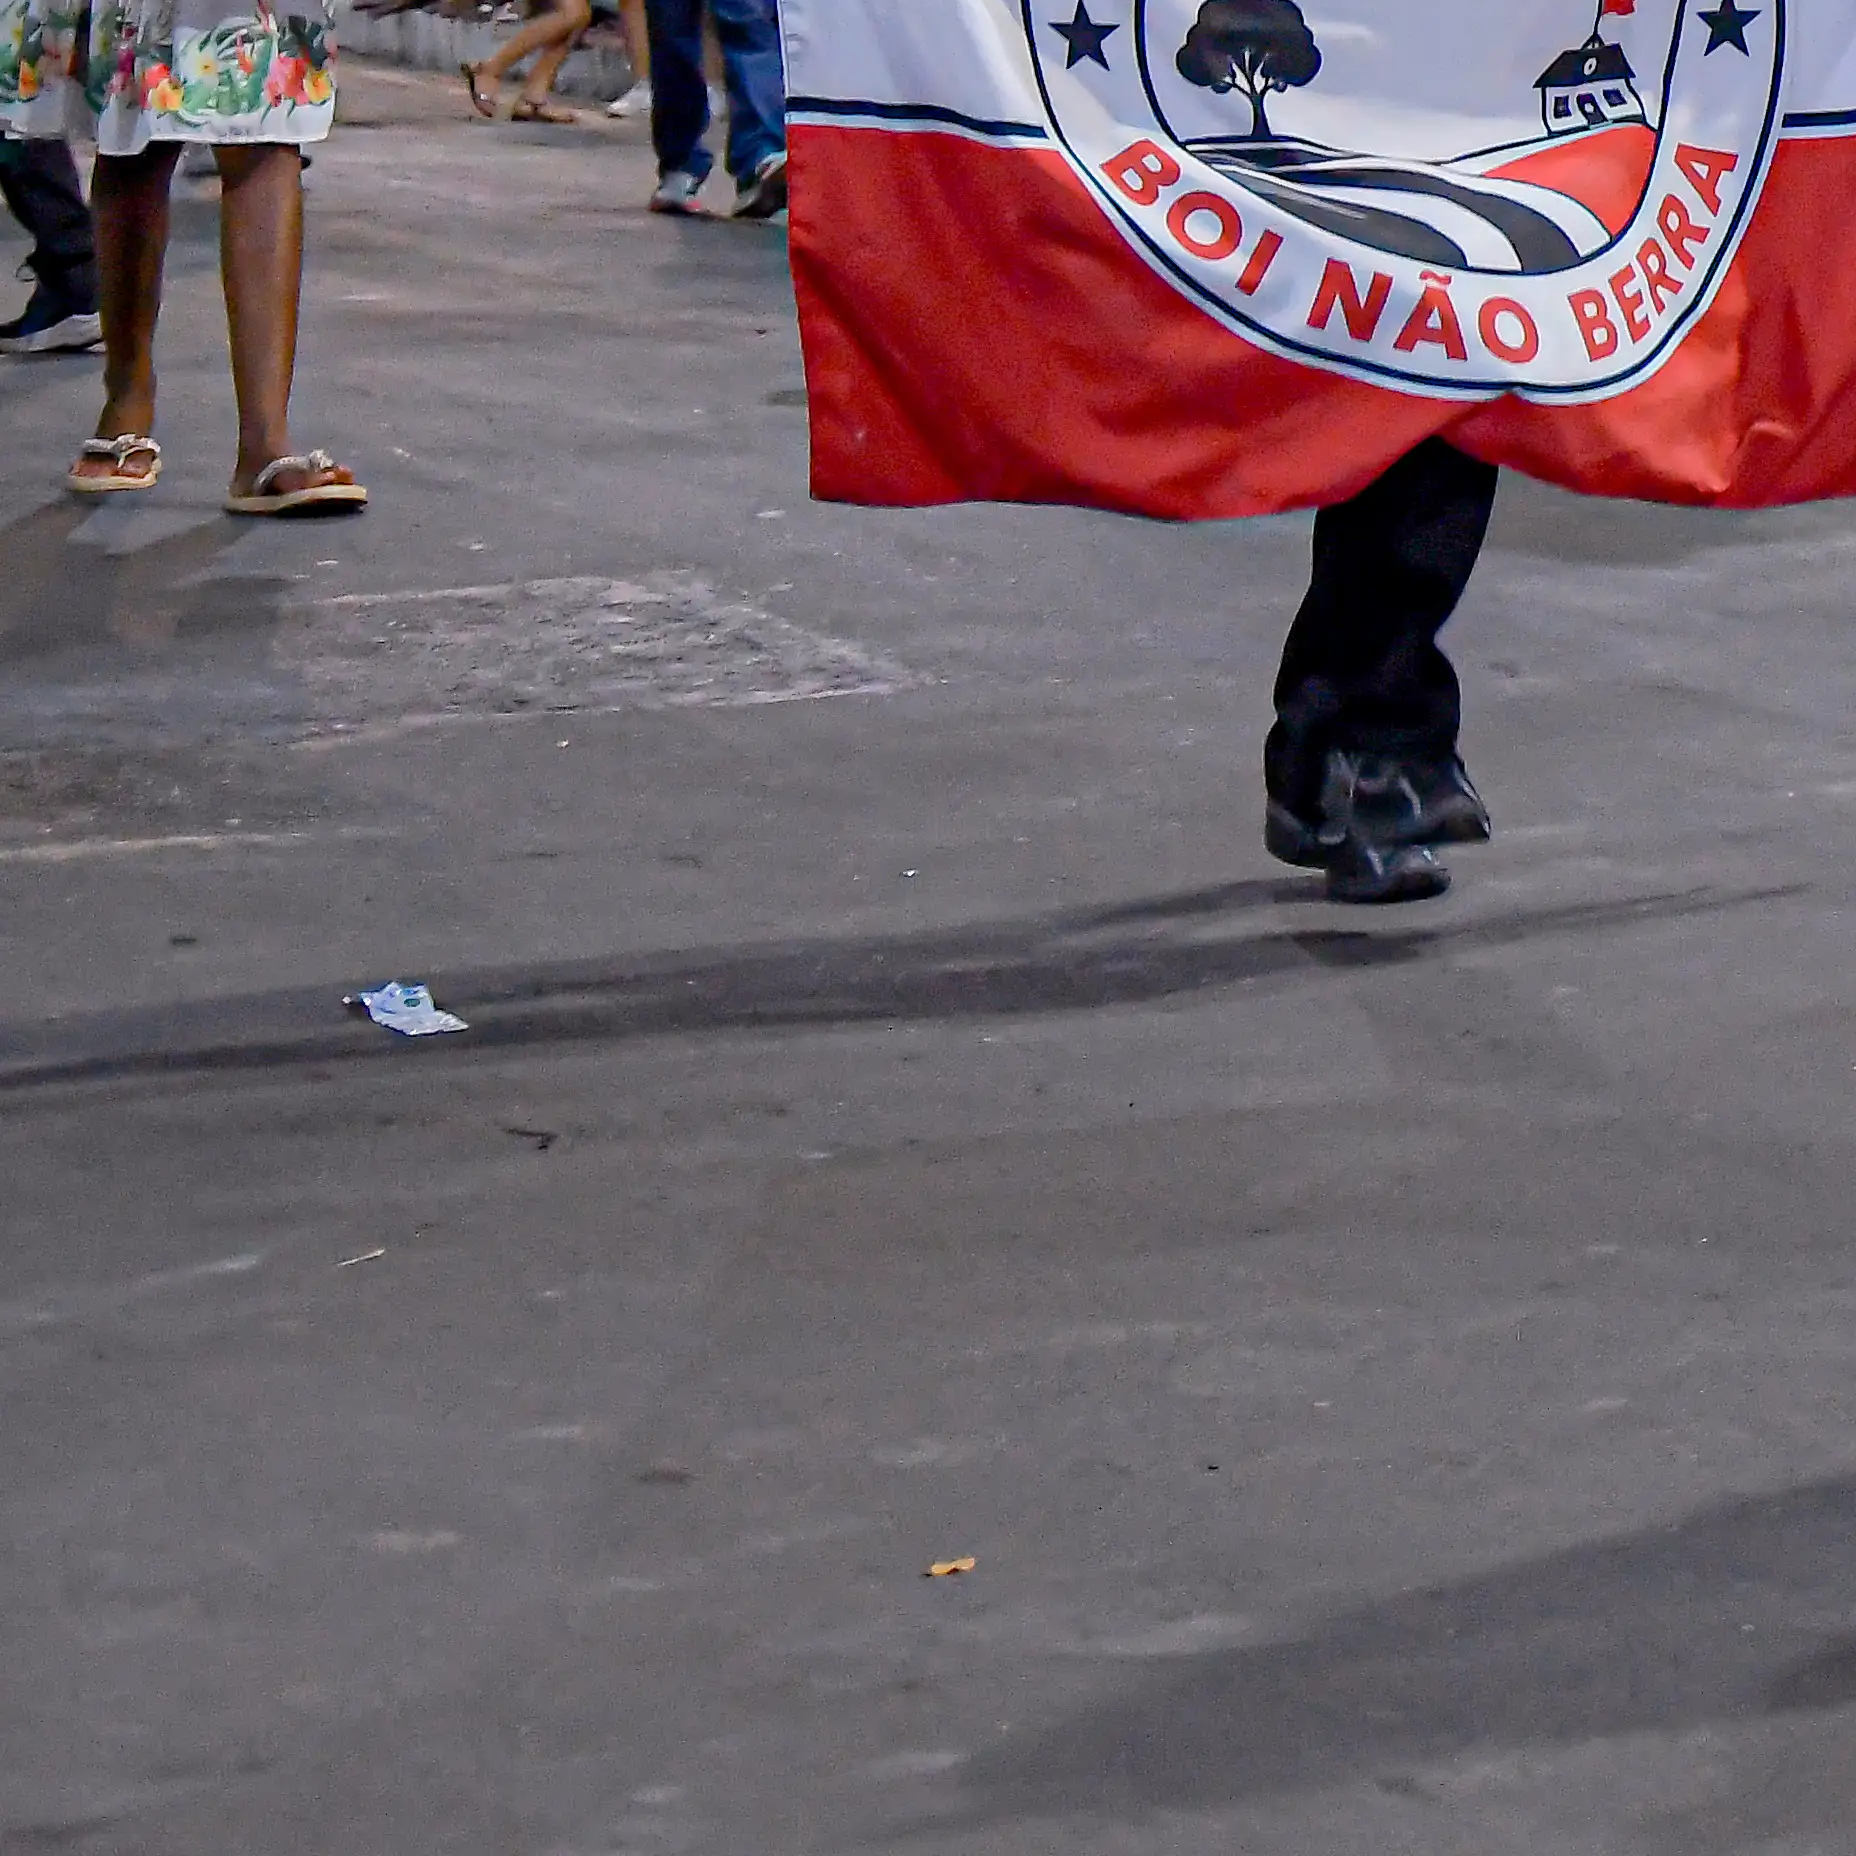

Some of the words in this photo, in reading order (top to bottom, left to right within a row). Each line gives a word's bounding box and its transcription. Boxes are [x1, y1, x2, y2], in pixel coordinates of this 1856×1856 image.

[1101, 139, 1282, 295] BOI
[1307, 258, 1538, 364] NÃO
[1569, 144, 1739, 361] BERRA
